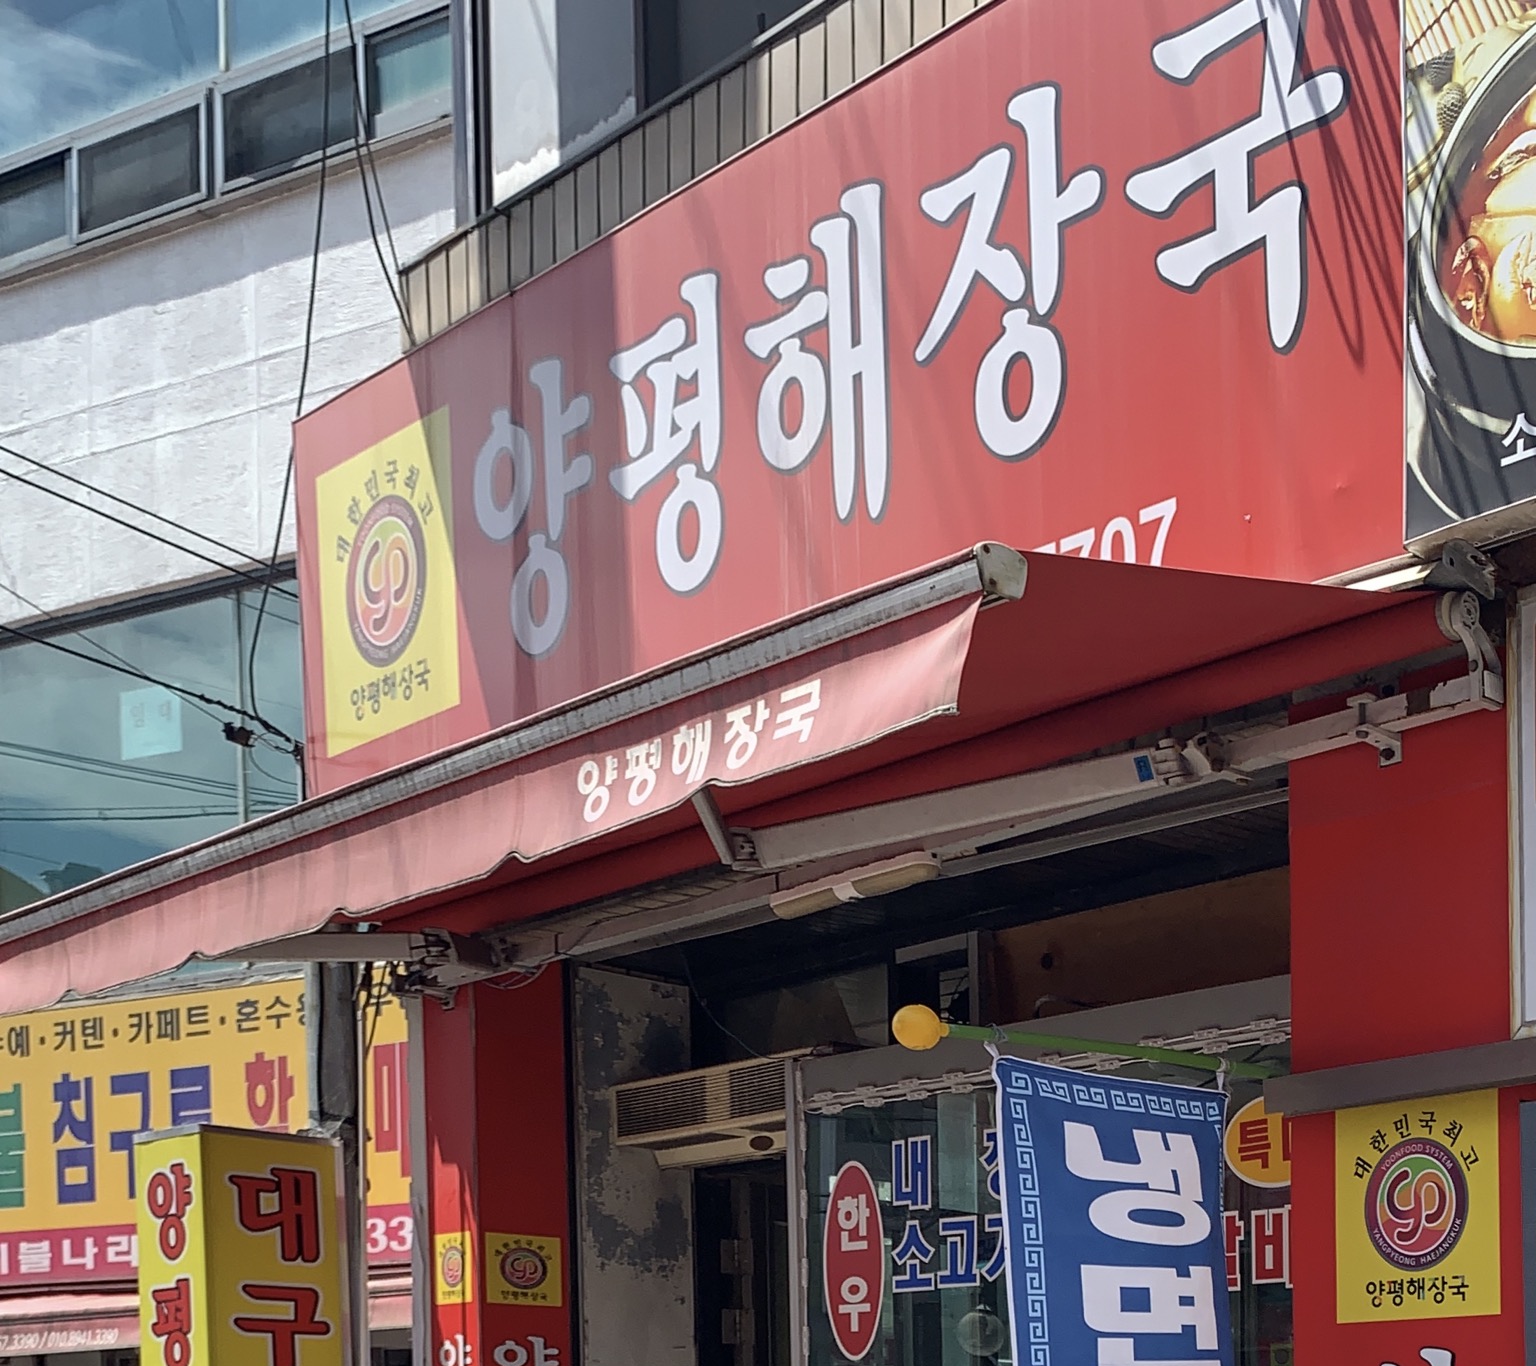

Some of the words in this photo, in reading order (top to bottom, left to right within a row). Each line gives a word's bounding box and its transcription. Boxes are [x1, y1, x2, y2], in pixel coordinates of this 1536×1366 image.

[473, 0, 1348, 656] 양평해장국
[577, 679, 822, 822] 양평해장국
[128, 1004, 211, 1044] 카페트
[1353, 1111, 1479, 1180] 대한민국최고
[1380, 1144, 1424, 1172] YOONFOOD
[1425, 1144, 1454, 1171] SYSTEM
[836, 1193, 872, 1333] 한우
[1365, 1275, 1469, 1308] 양평해장국
